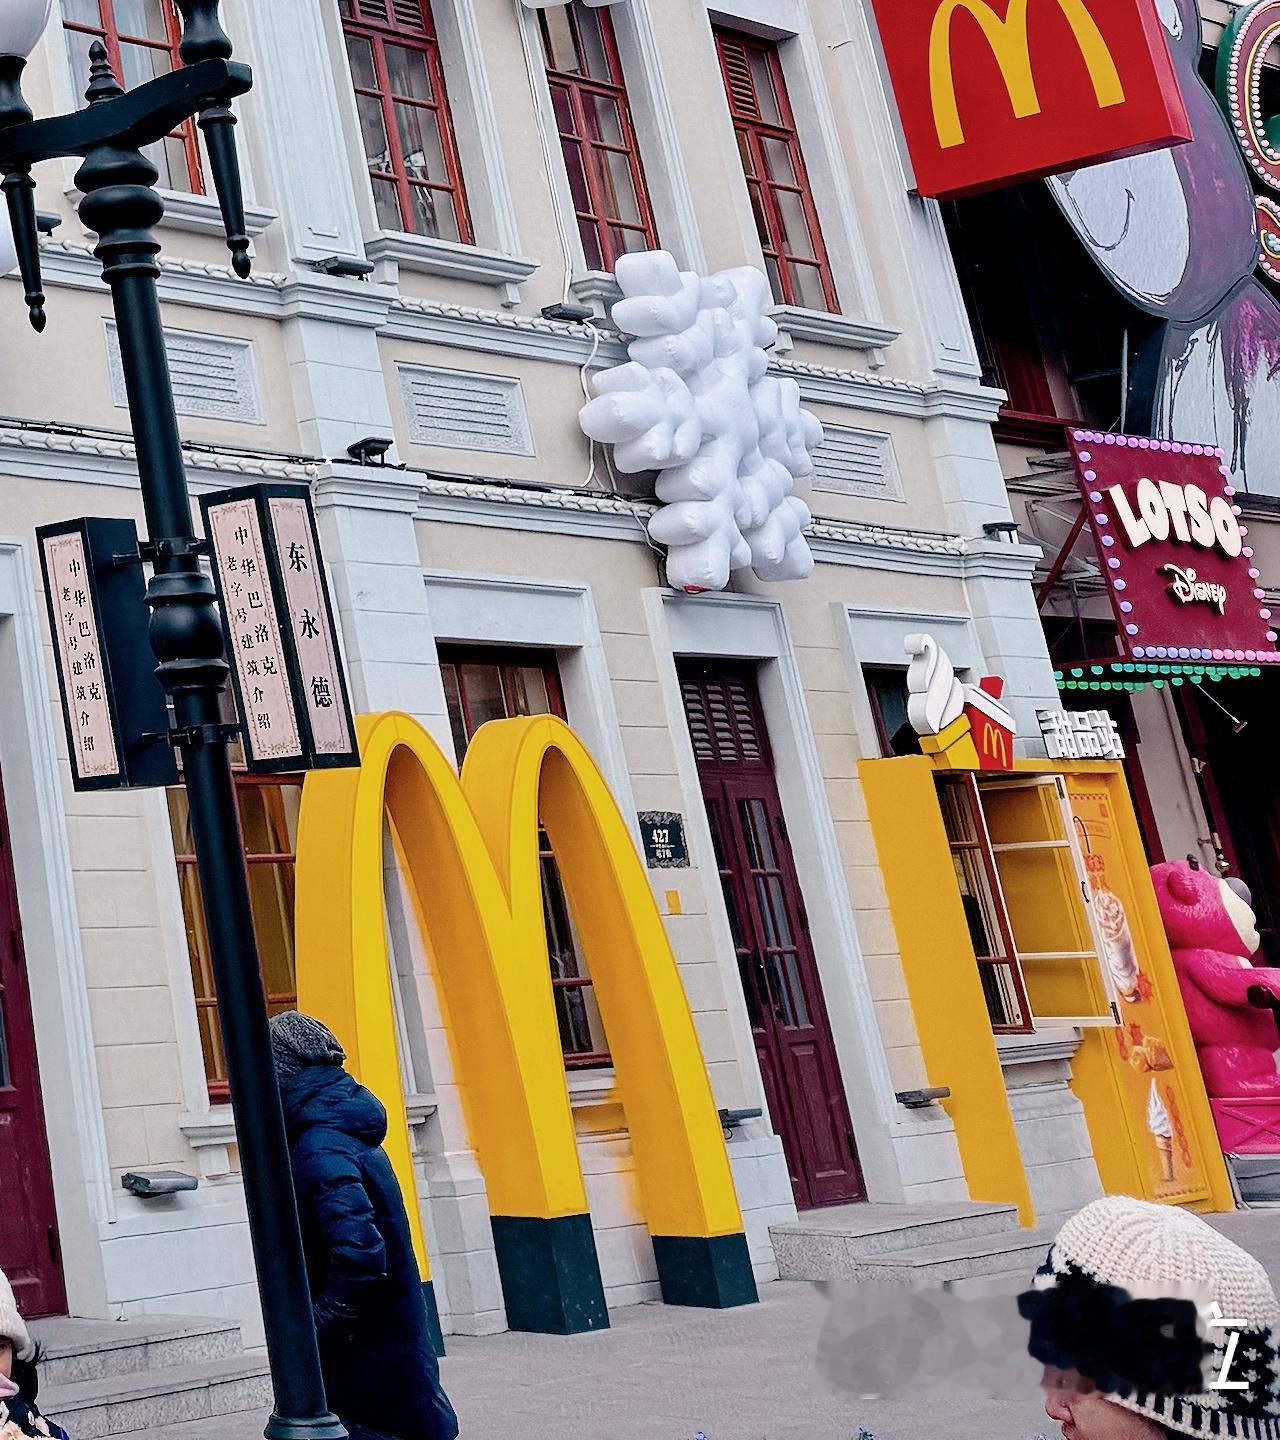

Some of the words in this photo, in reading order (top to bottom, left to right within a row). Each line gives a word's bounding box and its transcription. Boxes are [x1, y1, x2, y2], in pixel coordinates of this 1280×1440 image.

[1107, 477, 1243, 558] LOTSO
[62, 587, 96, 752] 老字号建筑介绍
[69, 558, 102, 702] 中华巴洛克
[226, 556, 271, 730] 老字号建筑介绍
[234, 525, 278, 677] 中华巴洛克
[285, 541, 333, 708] 东永德
[1039, 709, 1126, 759] 甜品站
[651, 828, 669, 844] 427
